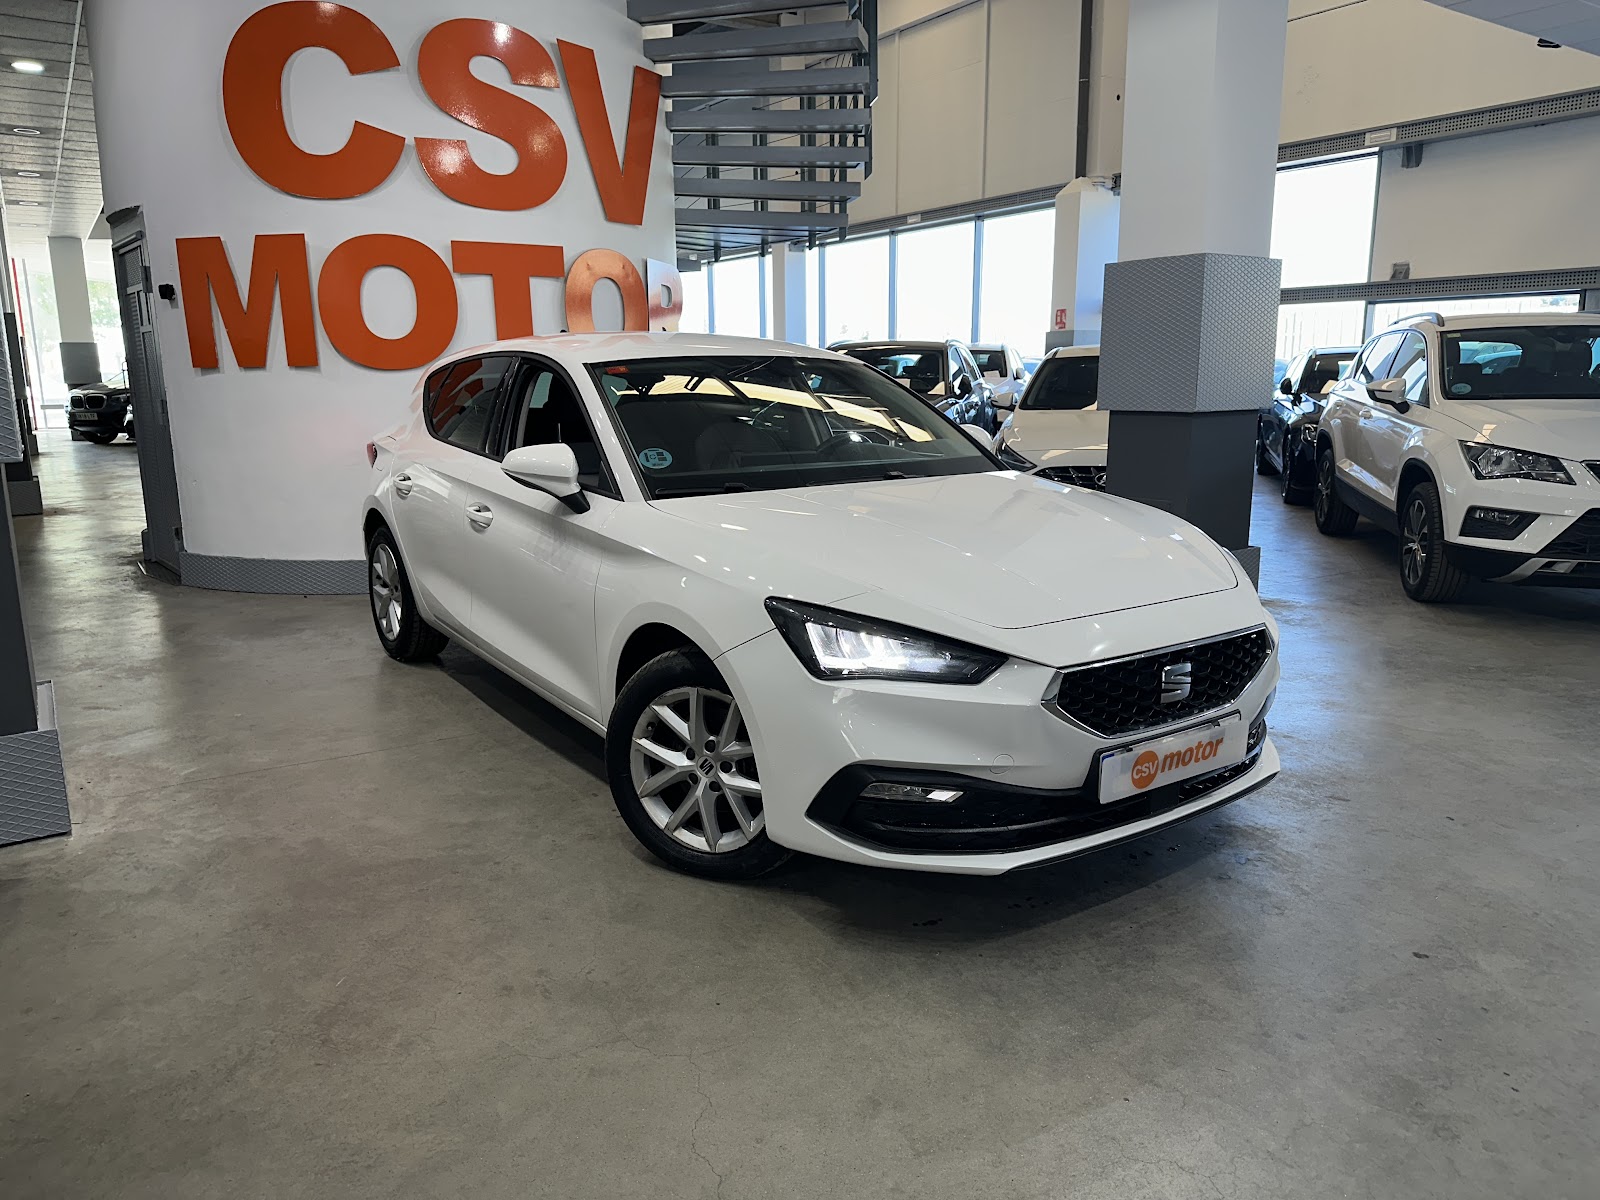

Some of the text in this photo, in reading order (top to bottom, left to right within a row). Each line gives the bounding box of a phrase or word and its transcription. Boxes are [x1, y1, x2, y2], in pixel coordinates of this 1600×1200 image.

[222, 0, 663, 226] CSV
[175, 233, 684, 371] MOTOR
[1160, 737, 1224, 773] motor
